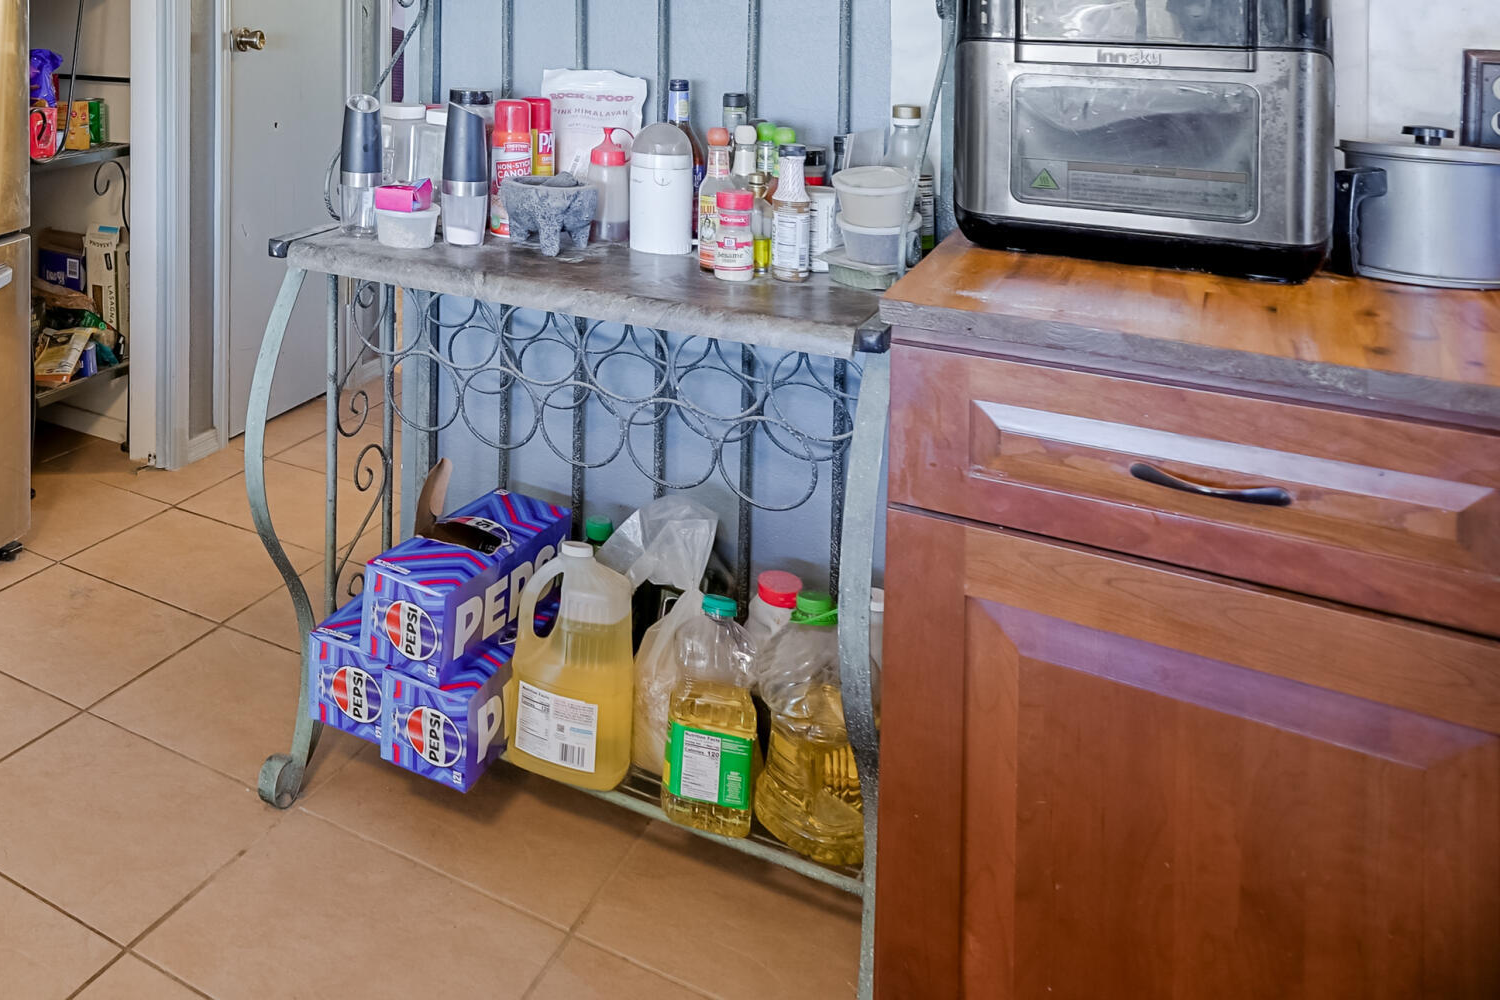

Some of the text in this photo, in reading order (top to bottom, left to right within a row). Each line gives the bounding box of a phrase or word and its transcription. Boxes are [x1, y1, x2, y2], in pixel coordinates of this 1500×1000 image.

[574, 108, 628, 116] HIMALAYAN
[539, 132, 554, 153] PA
[107, 285, 115, 325] LASAGNA
[405, 606, 418, 656] PEPSI
[353, 670, 363, 719] PEPSI
[429, 712, 441, 763] PEPSI
